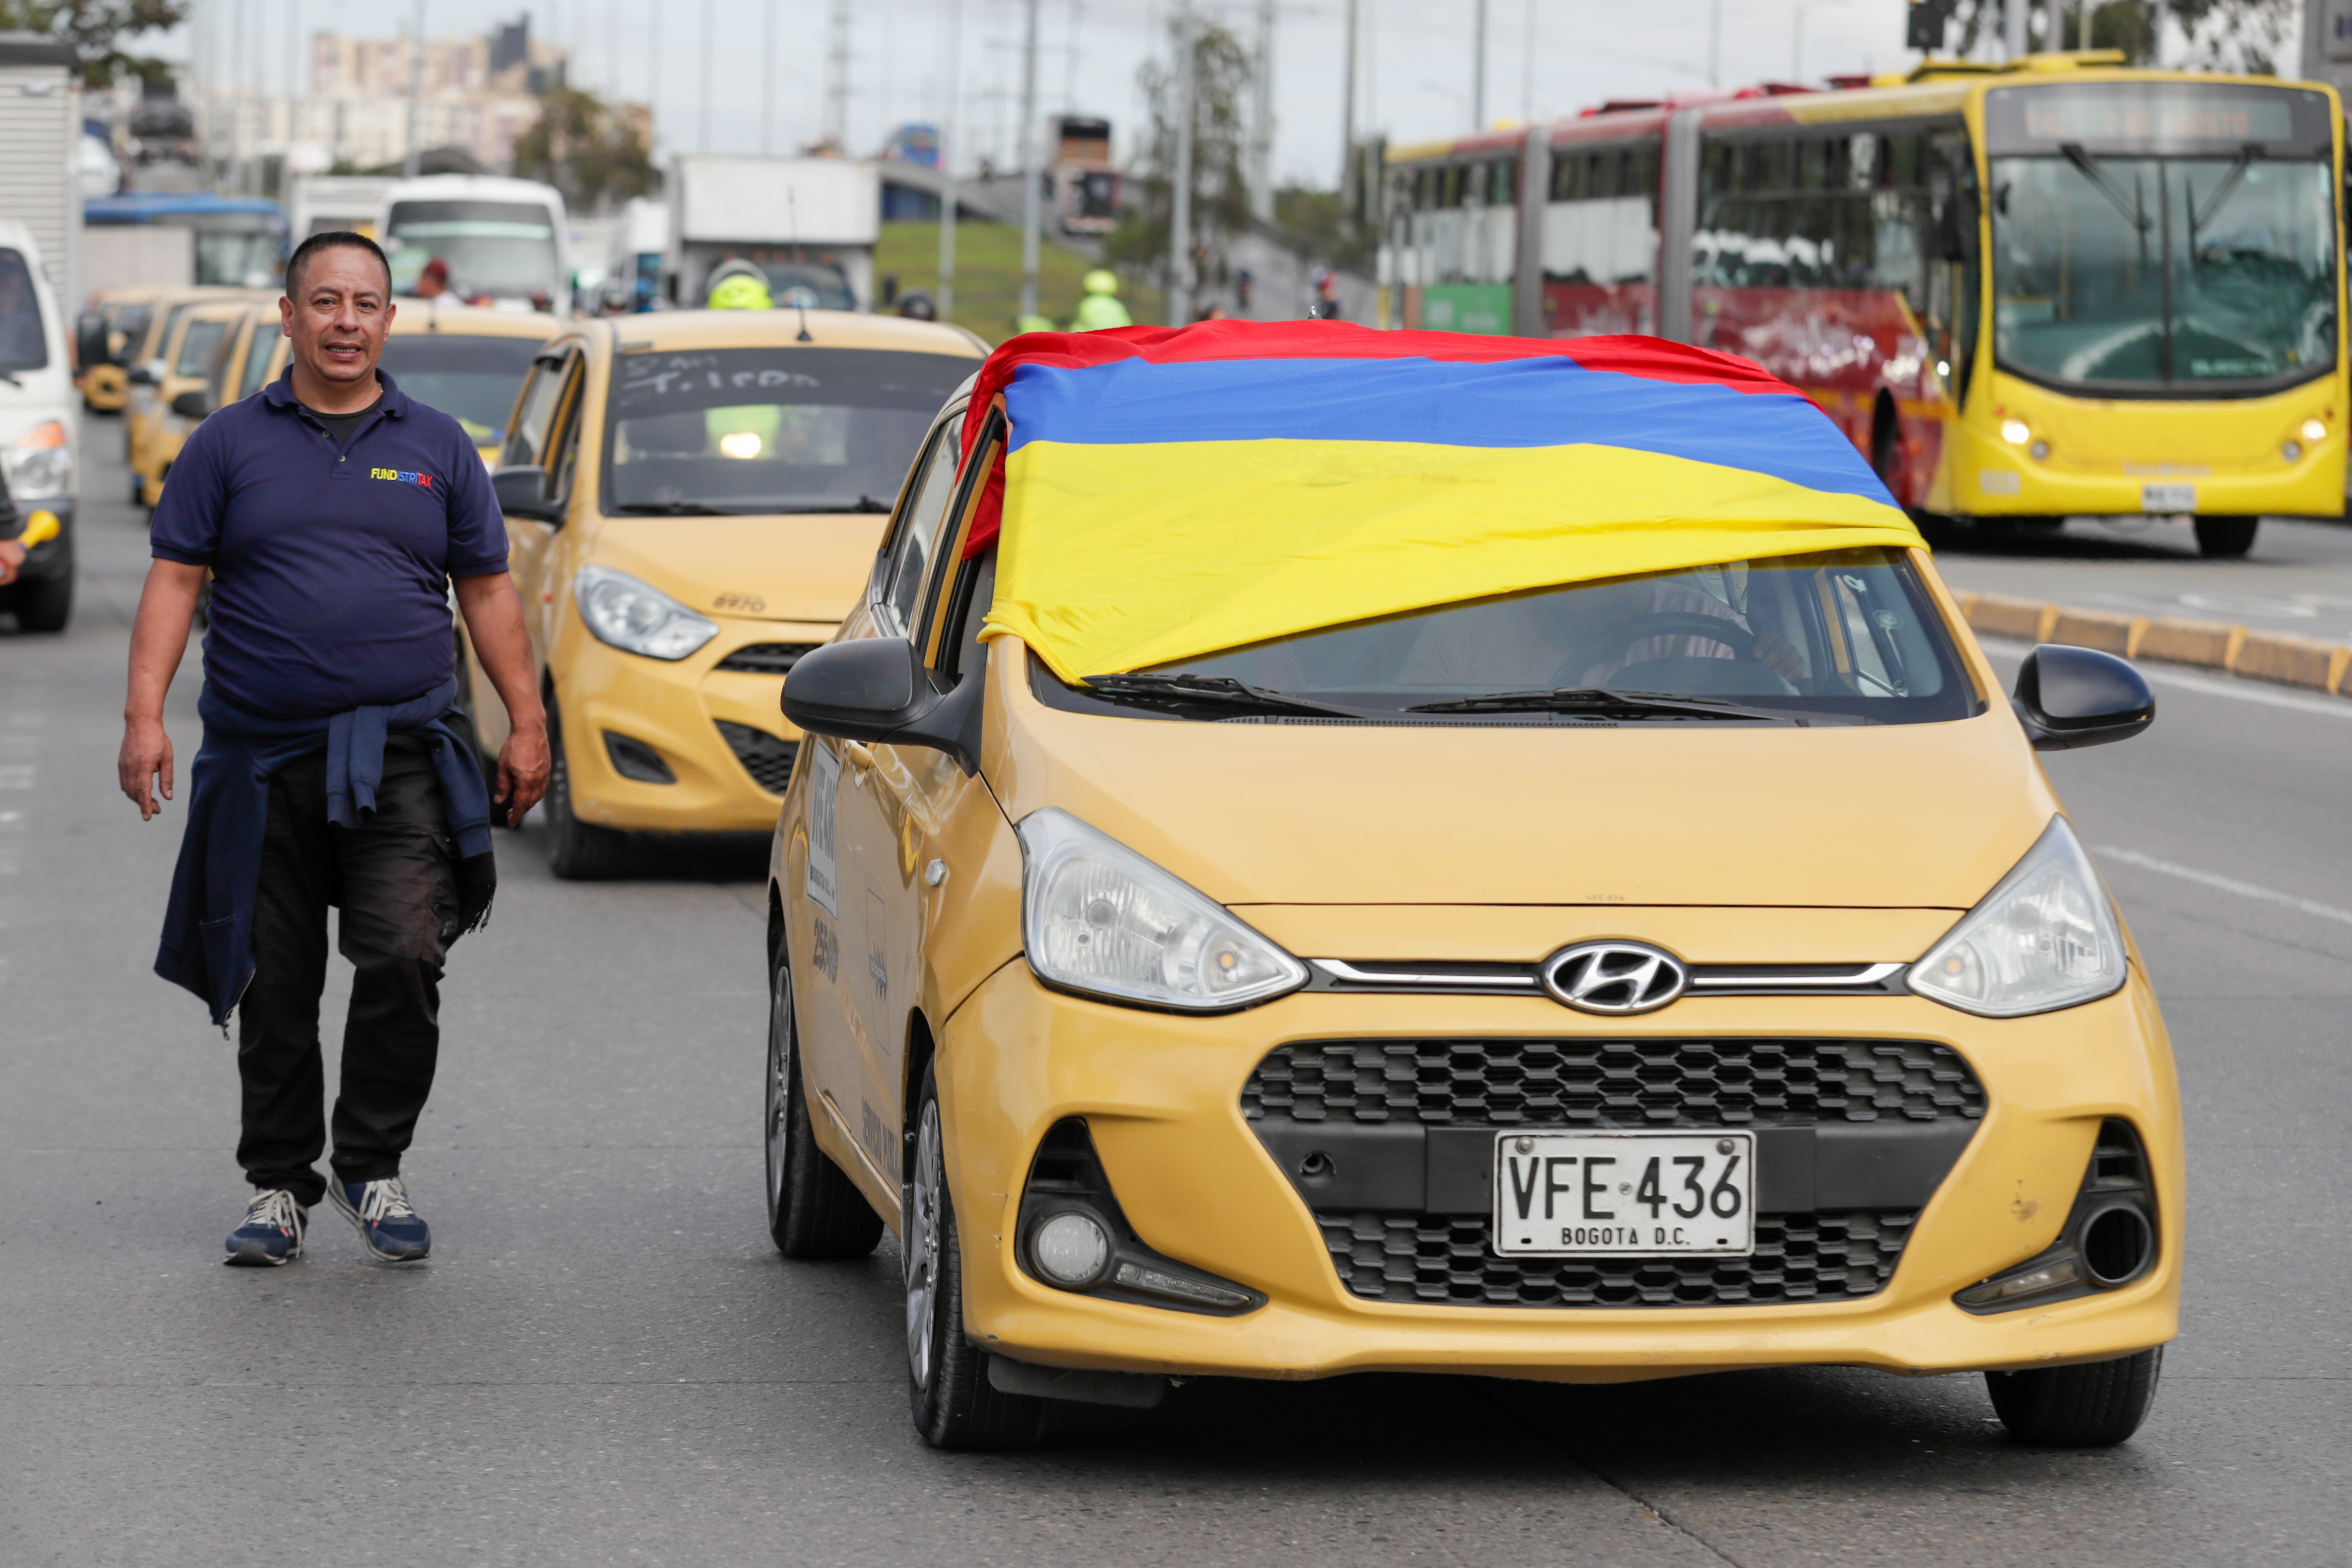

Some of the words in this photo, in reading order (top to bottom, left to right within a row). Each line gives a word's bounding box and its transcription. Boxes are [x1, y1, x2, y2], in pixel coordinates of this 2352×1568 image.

[371, 468, 433, 488] FUNDISTRITAX
[1509, 1156, 1616, 1219] VFE
[1637, 1155, 1742, 1219] 436
[1561, 1227, 1638, 1245] BOGOTA
[1655, 1228, 1691, 1245] D.C.
